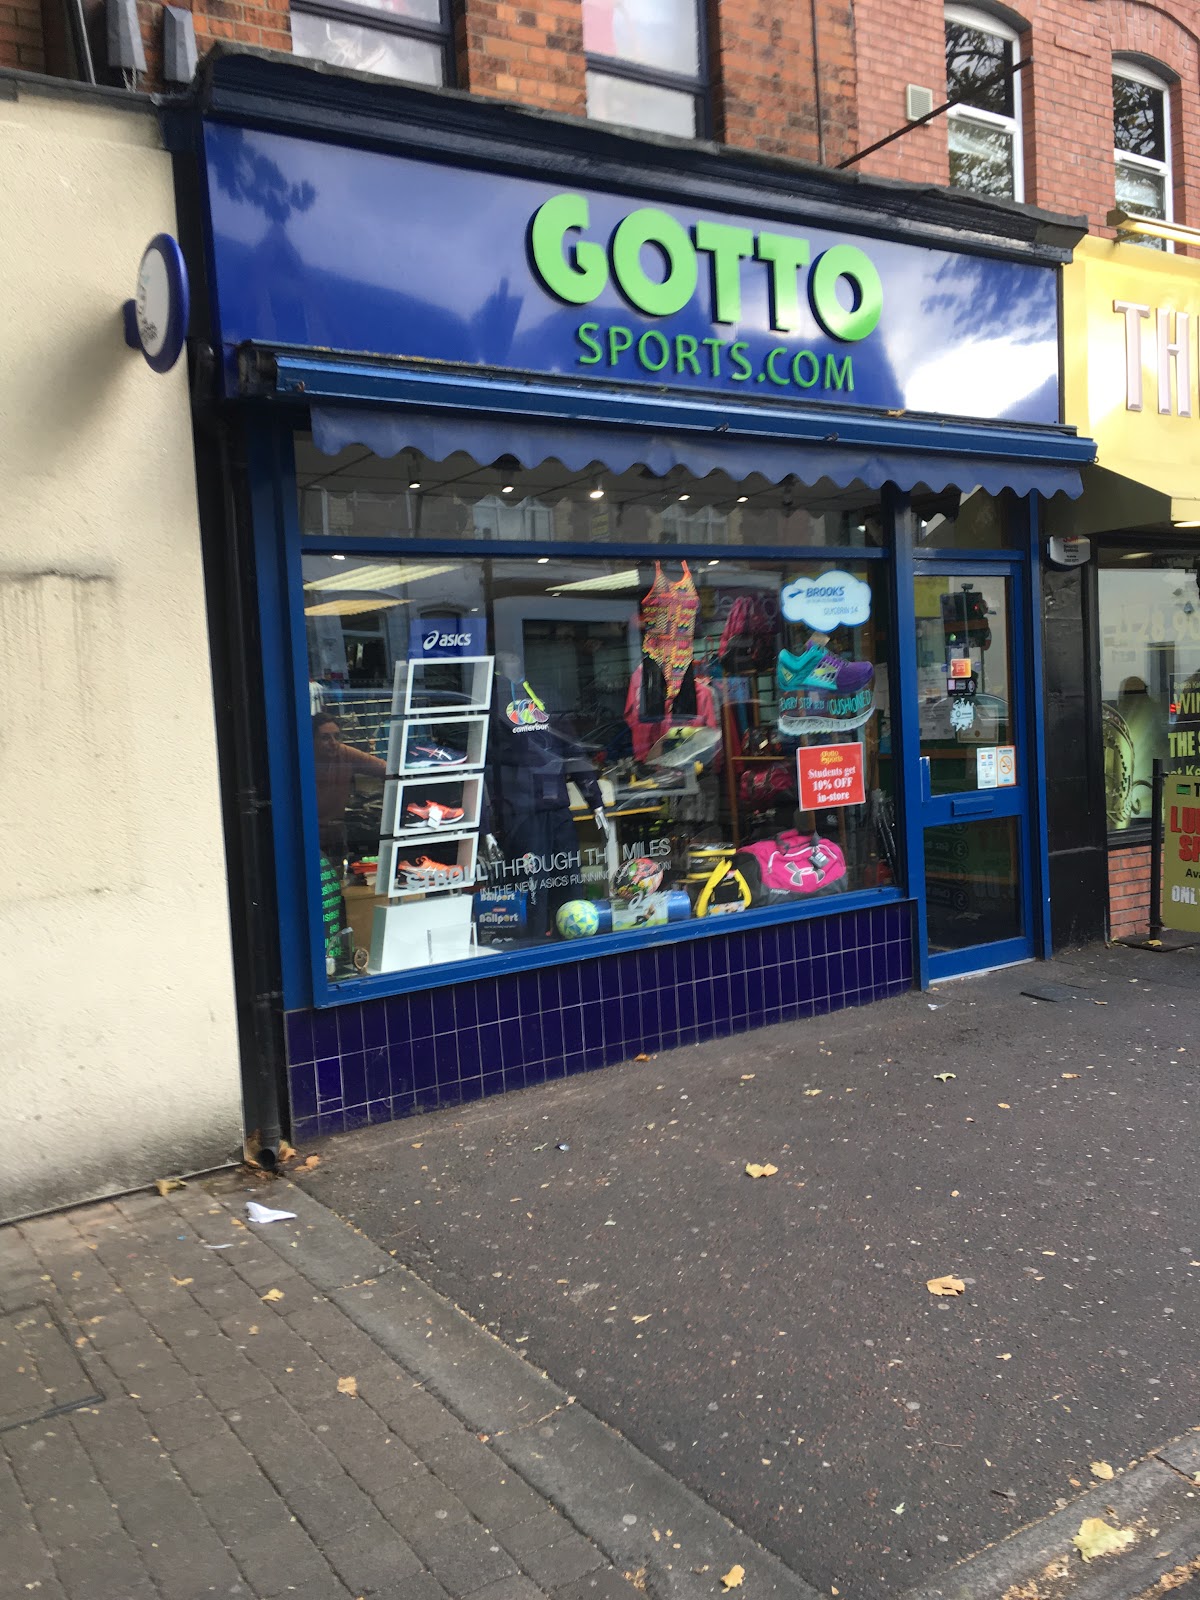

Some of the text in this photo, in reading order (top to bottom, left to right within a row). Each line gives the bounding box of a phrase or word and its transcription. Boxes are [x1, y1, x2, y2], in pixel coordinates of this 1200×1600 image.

[526, 192, 883, 342] GOTTO
[575, 321, 855, 392] SPORTS.COM
[1113, 299, 1200, 418] TH
[806, 587, 845, 598] BROOKS
[1168, 731, 1195, 758] THE
[808, 766, 856, 779] Students get
[812, 777, 853, 791] 10% OFF
[817, 792, 850, 803] in-store
[406, 838, 672, 892] STROLL THROUGH TH MILES
[480, 886, 490, 895] IN
[492, 884, 514, 896] THE
[540, 876, 568, 889] ASICS
[1172, 885, 1200, 905] ONL
[479, 913, 519, 924] Ballport
